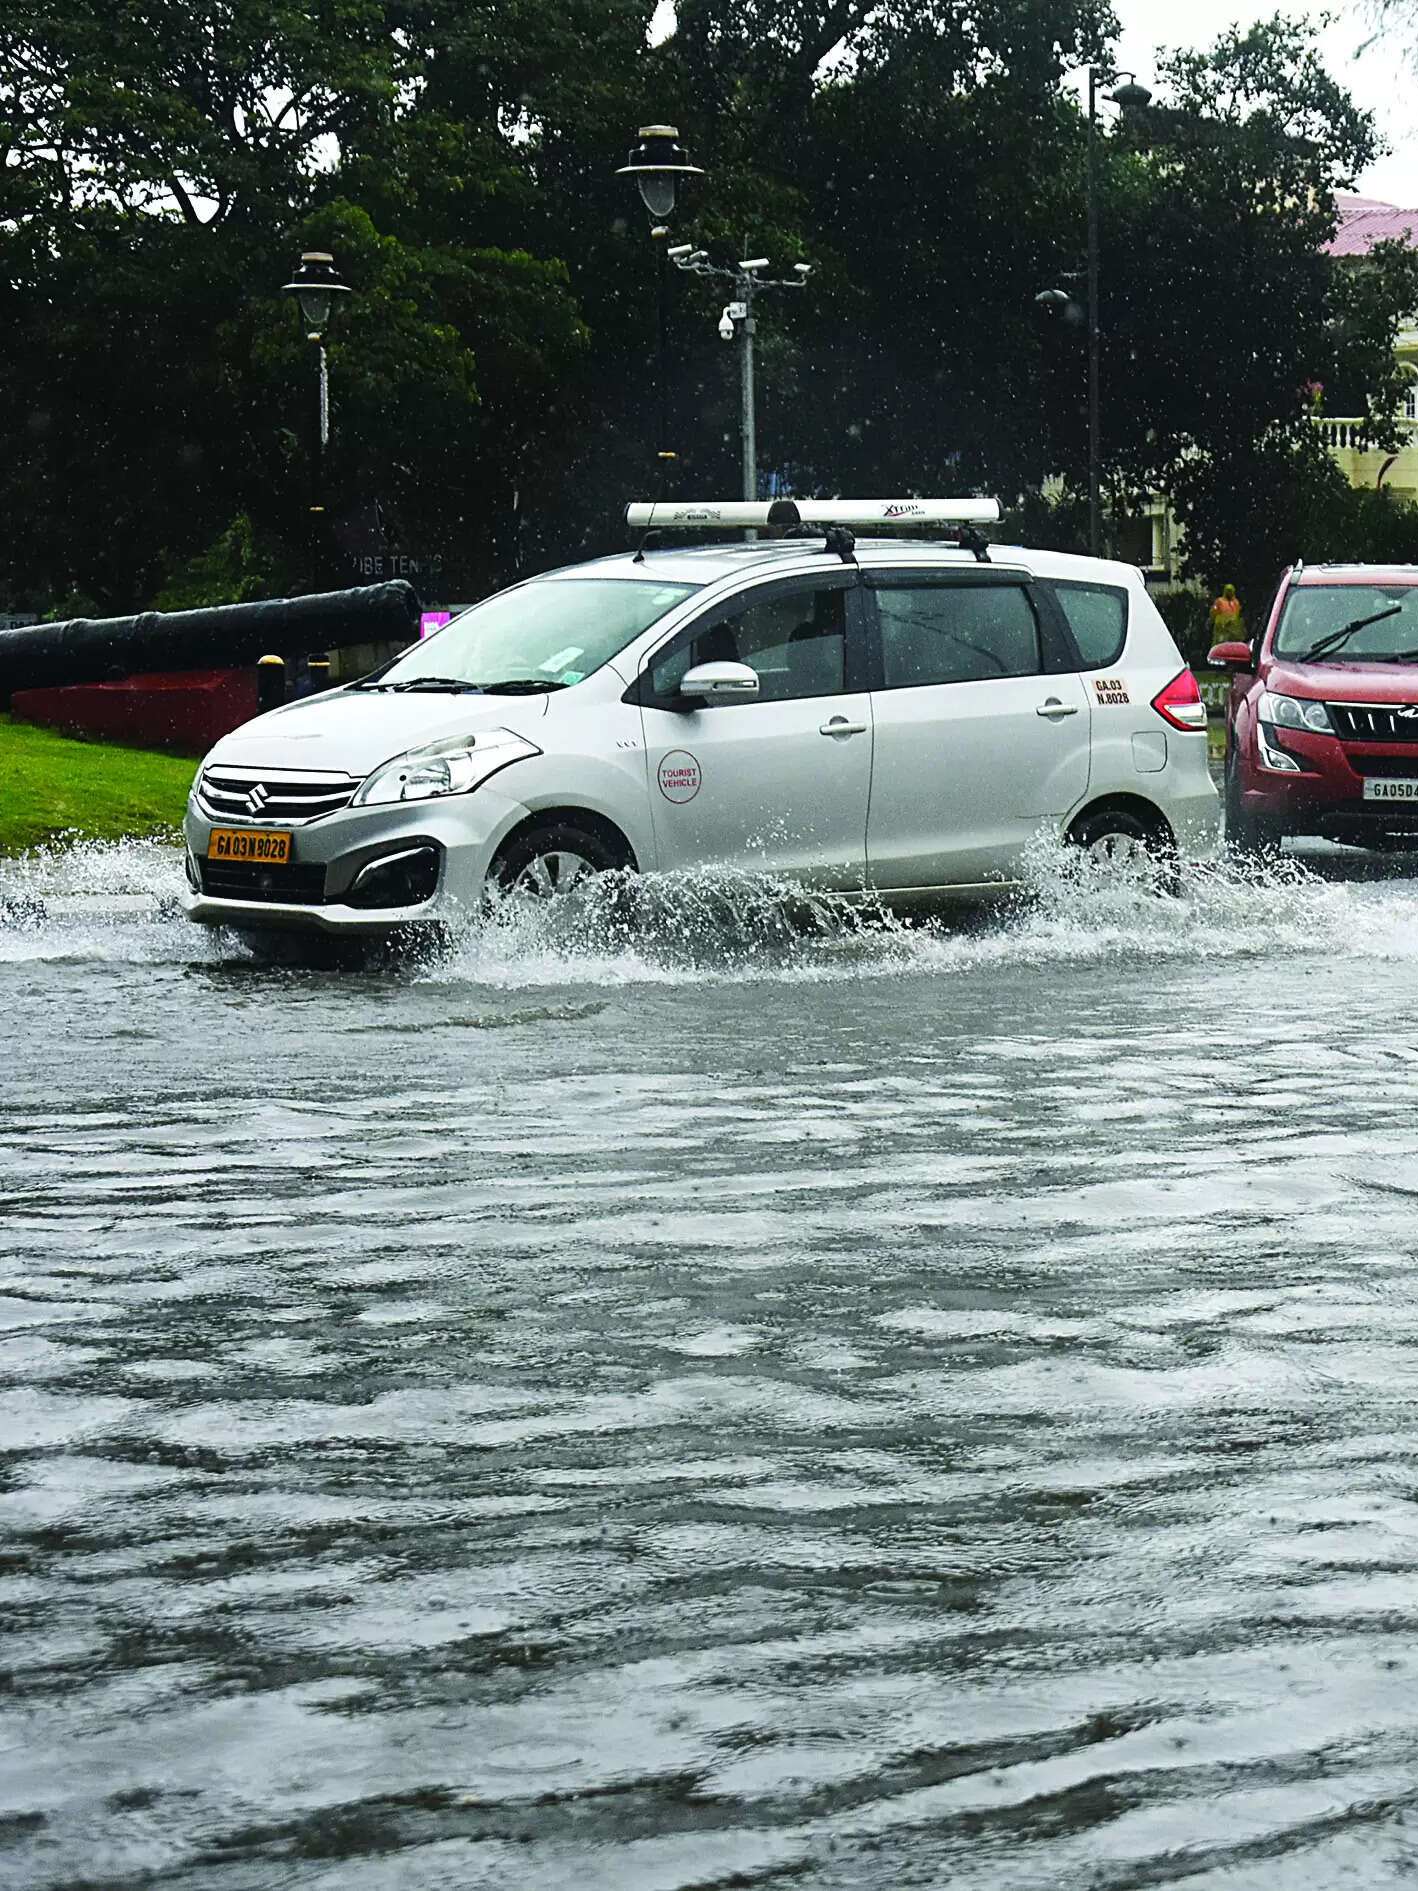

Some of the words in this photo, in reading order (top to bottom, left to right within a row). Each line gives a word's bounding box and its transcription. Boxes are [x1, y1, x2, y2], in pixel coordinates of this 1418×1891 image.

[1096, 693, 1130, 704] N.8028
[662, 768, 697, 778] TOURIST
[662, 778, 697, 788] VEHICLE
